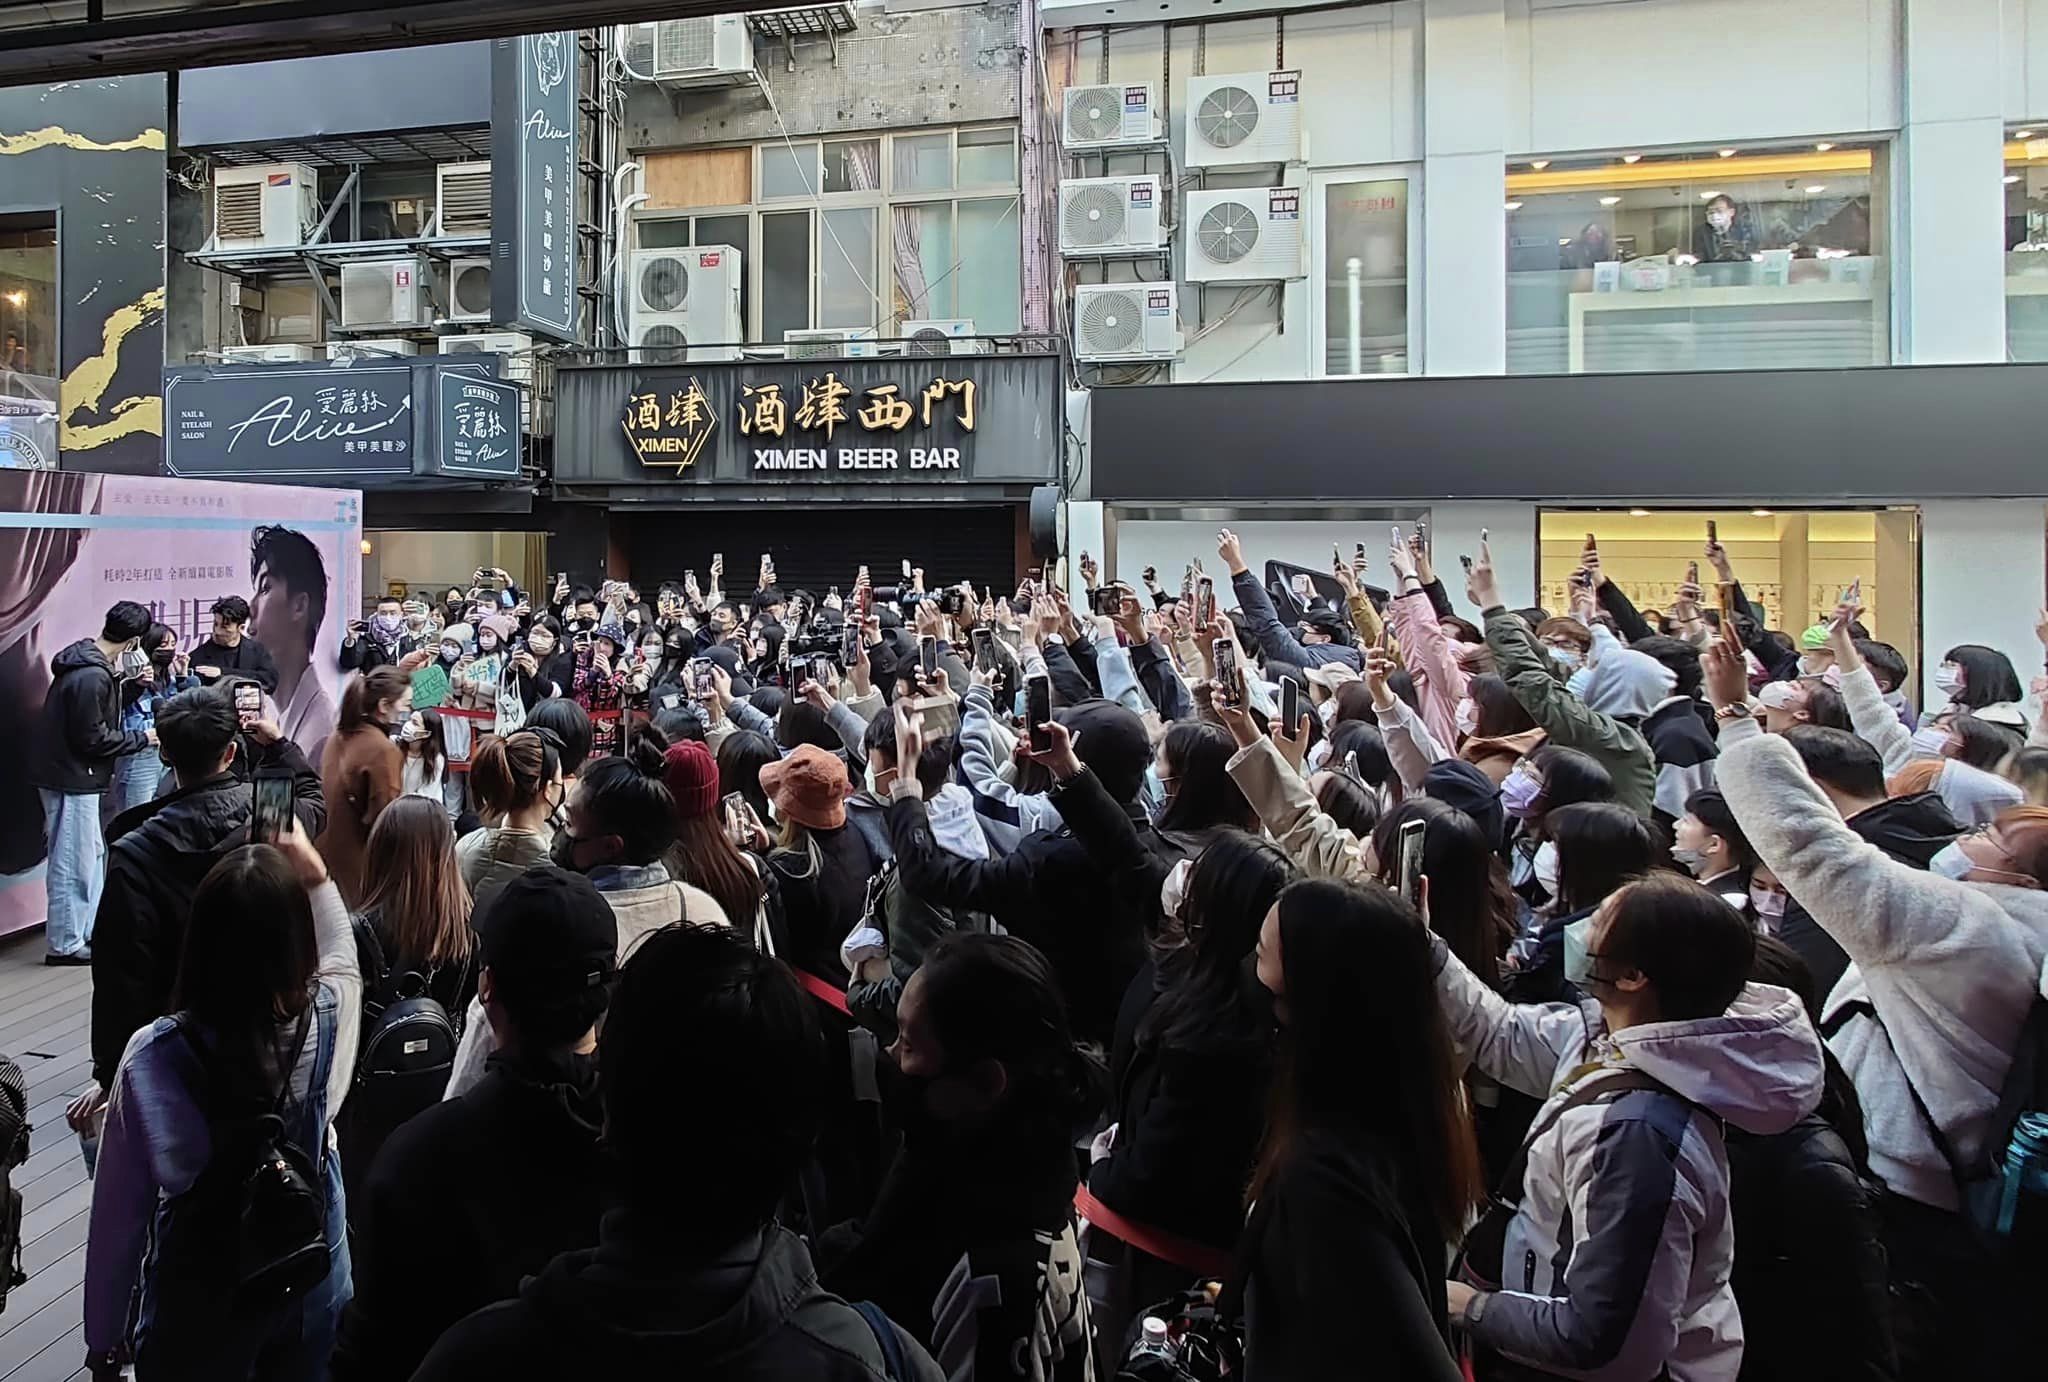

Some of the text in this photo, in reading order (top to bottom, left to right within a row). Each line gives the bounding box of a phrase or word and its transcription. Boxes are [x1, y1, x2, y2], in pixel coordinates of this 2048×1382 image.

[181, 410, 198, 418] NAIL
[626, 385, 705, 436] 酒肆
[738, 371, 976, 442] 酒肆西門
[181, 421, 213, 429] EYELASH
[228, 395, 388, 453] Alice
[181, 432, 205, 440] SALON
[639, 437, 688, 453] XIMEN
[754, 447, 960, 470] XIMEN BEER BAR
